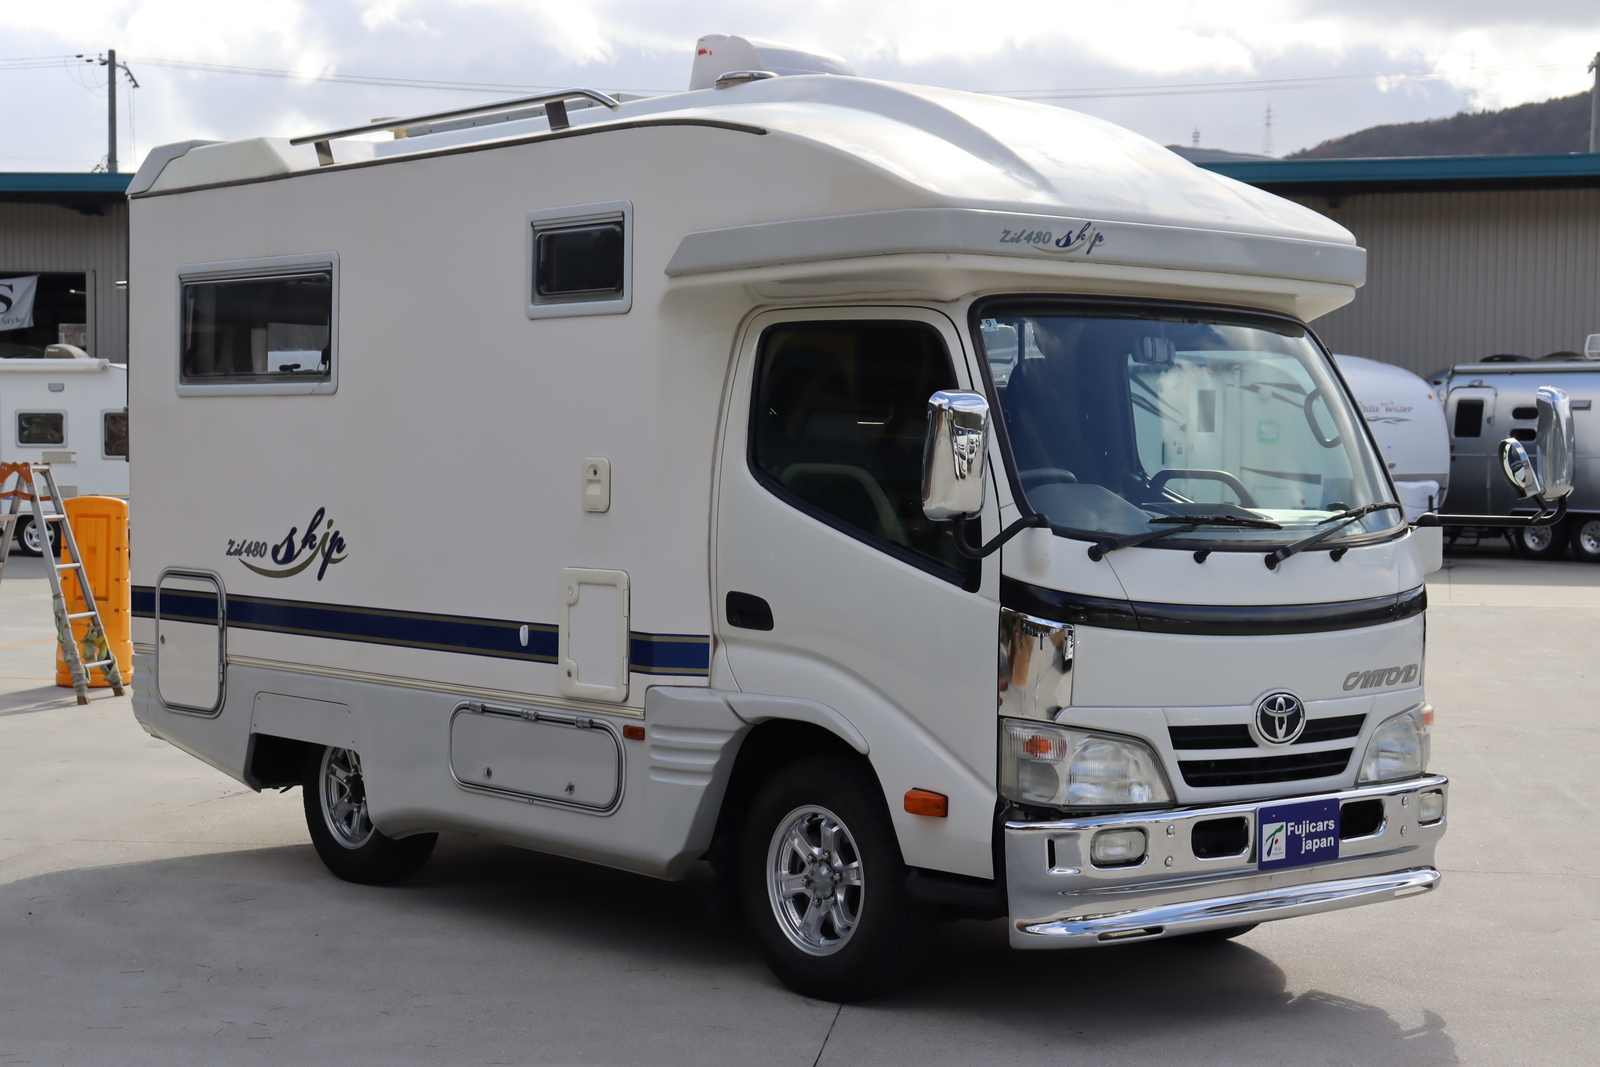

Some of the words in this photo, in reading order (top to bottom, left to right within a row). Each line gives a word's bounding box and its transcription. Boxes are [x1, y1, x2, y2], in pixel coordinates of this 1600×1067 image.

[985, 319, 992, 328] 9
[1381, 400, 1413, 413] Water
[1287, 819, 1335, 838] Fujicars
[1300, 836, 1334, 854] japan
